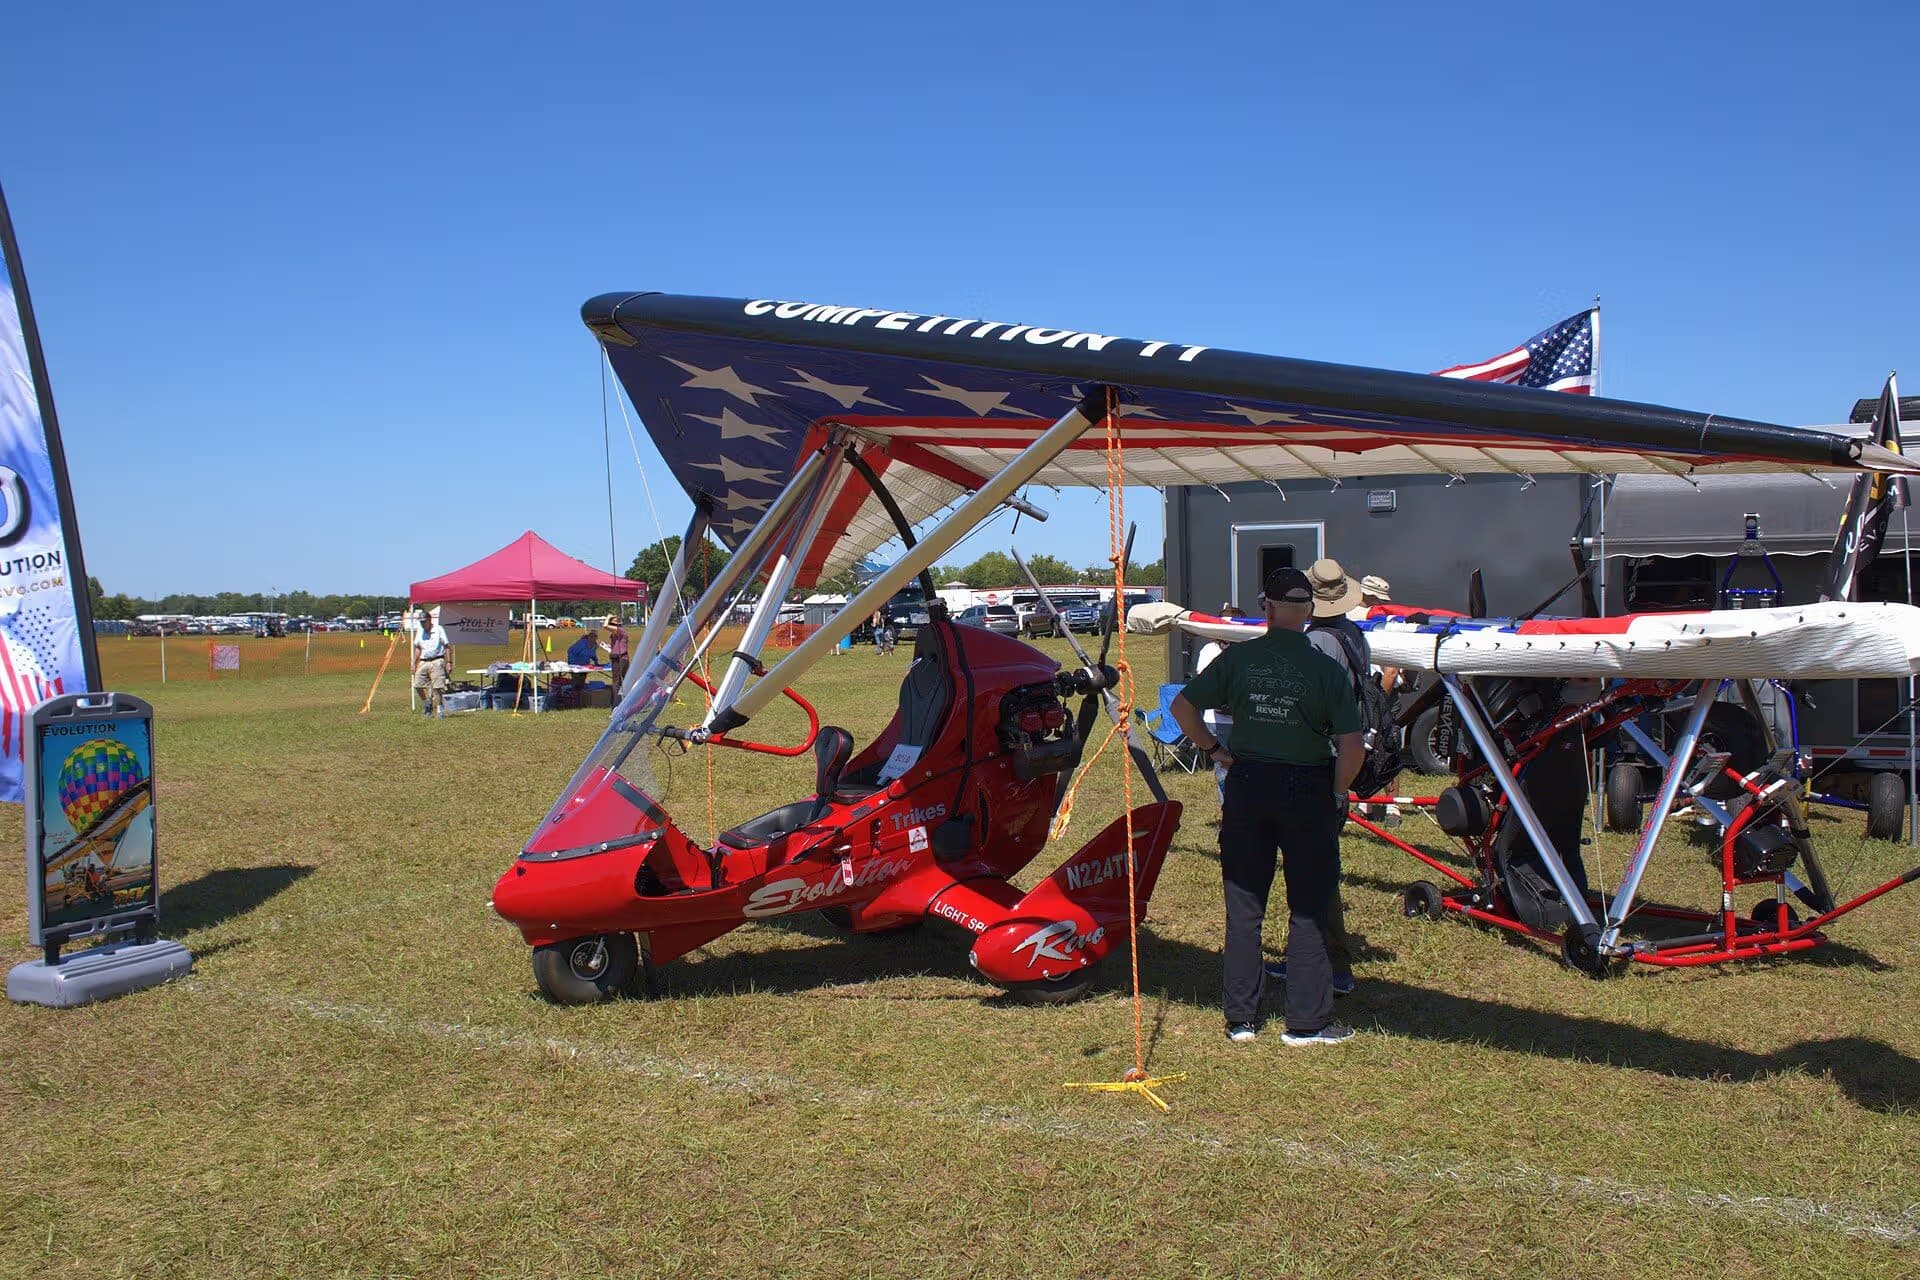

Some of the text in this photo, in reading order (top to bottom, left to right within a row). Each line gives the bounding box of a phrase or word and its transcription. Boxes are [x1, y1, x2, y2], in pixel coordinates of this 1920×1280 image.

[744, 299, 1120, 351] COMPETITION
[0, 576, 64, 598] VO.COM
[1256, 706, 1290, 718] REVOLT
[43, 723, 116, 736] EVOLUTION
[890, 804, 946, 831] Trikes
[934, 900, 989, 932] LIGHT SP
[1011, 920, 1104, 968] Revo
